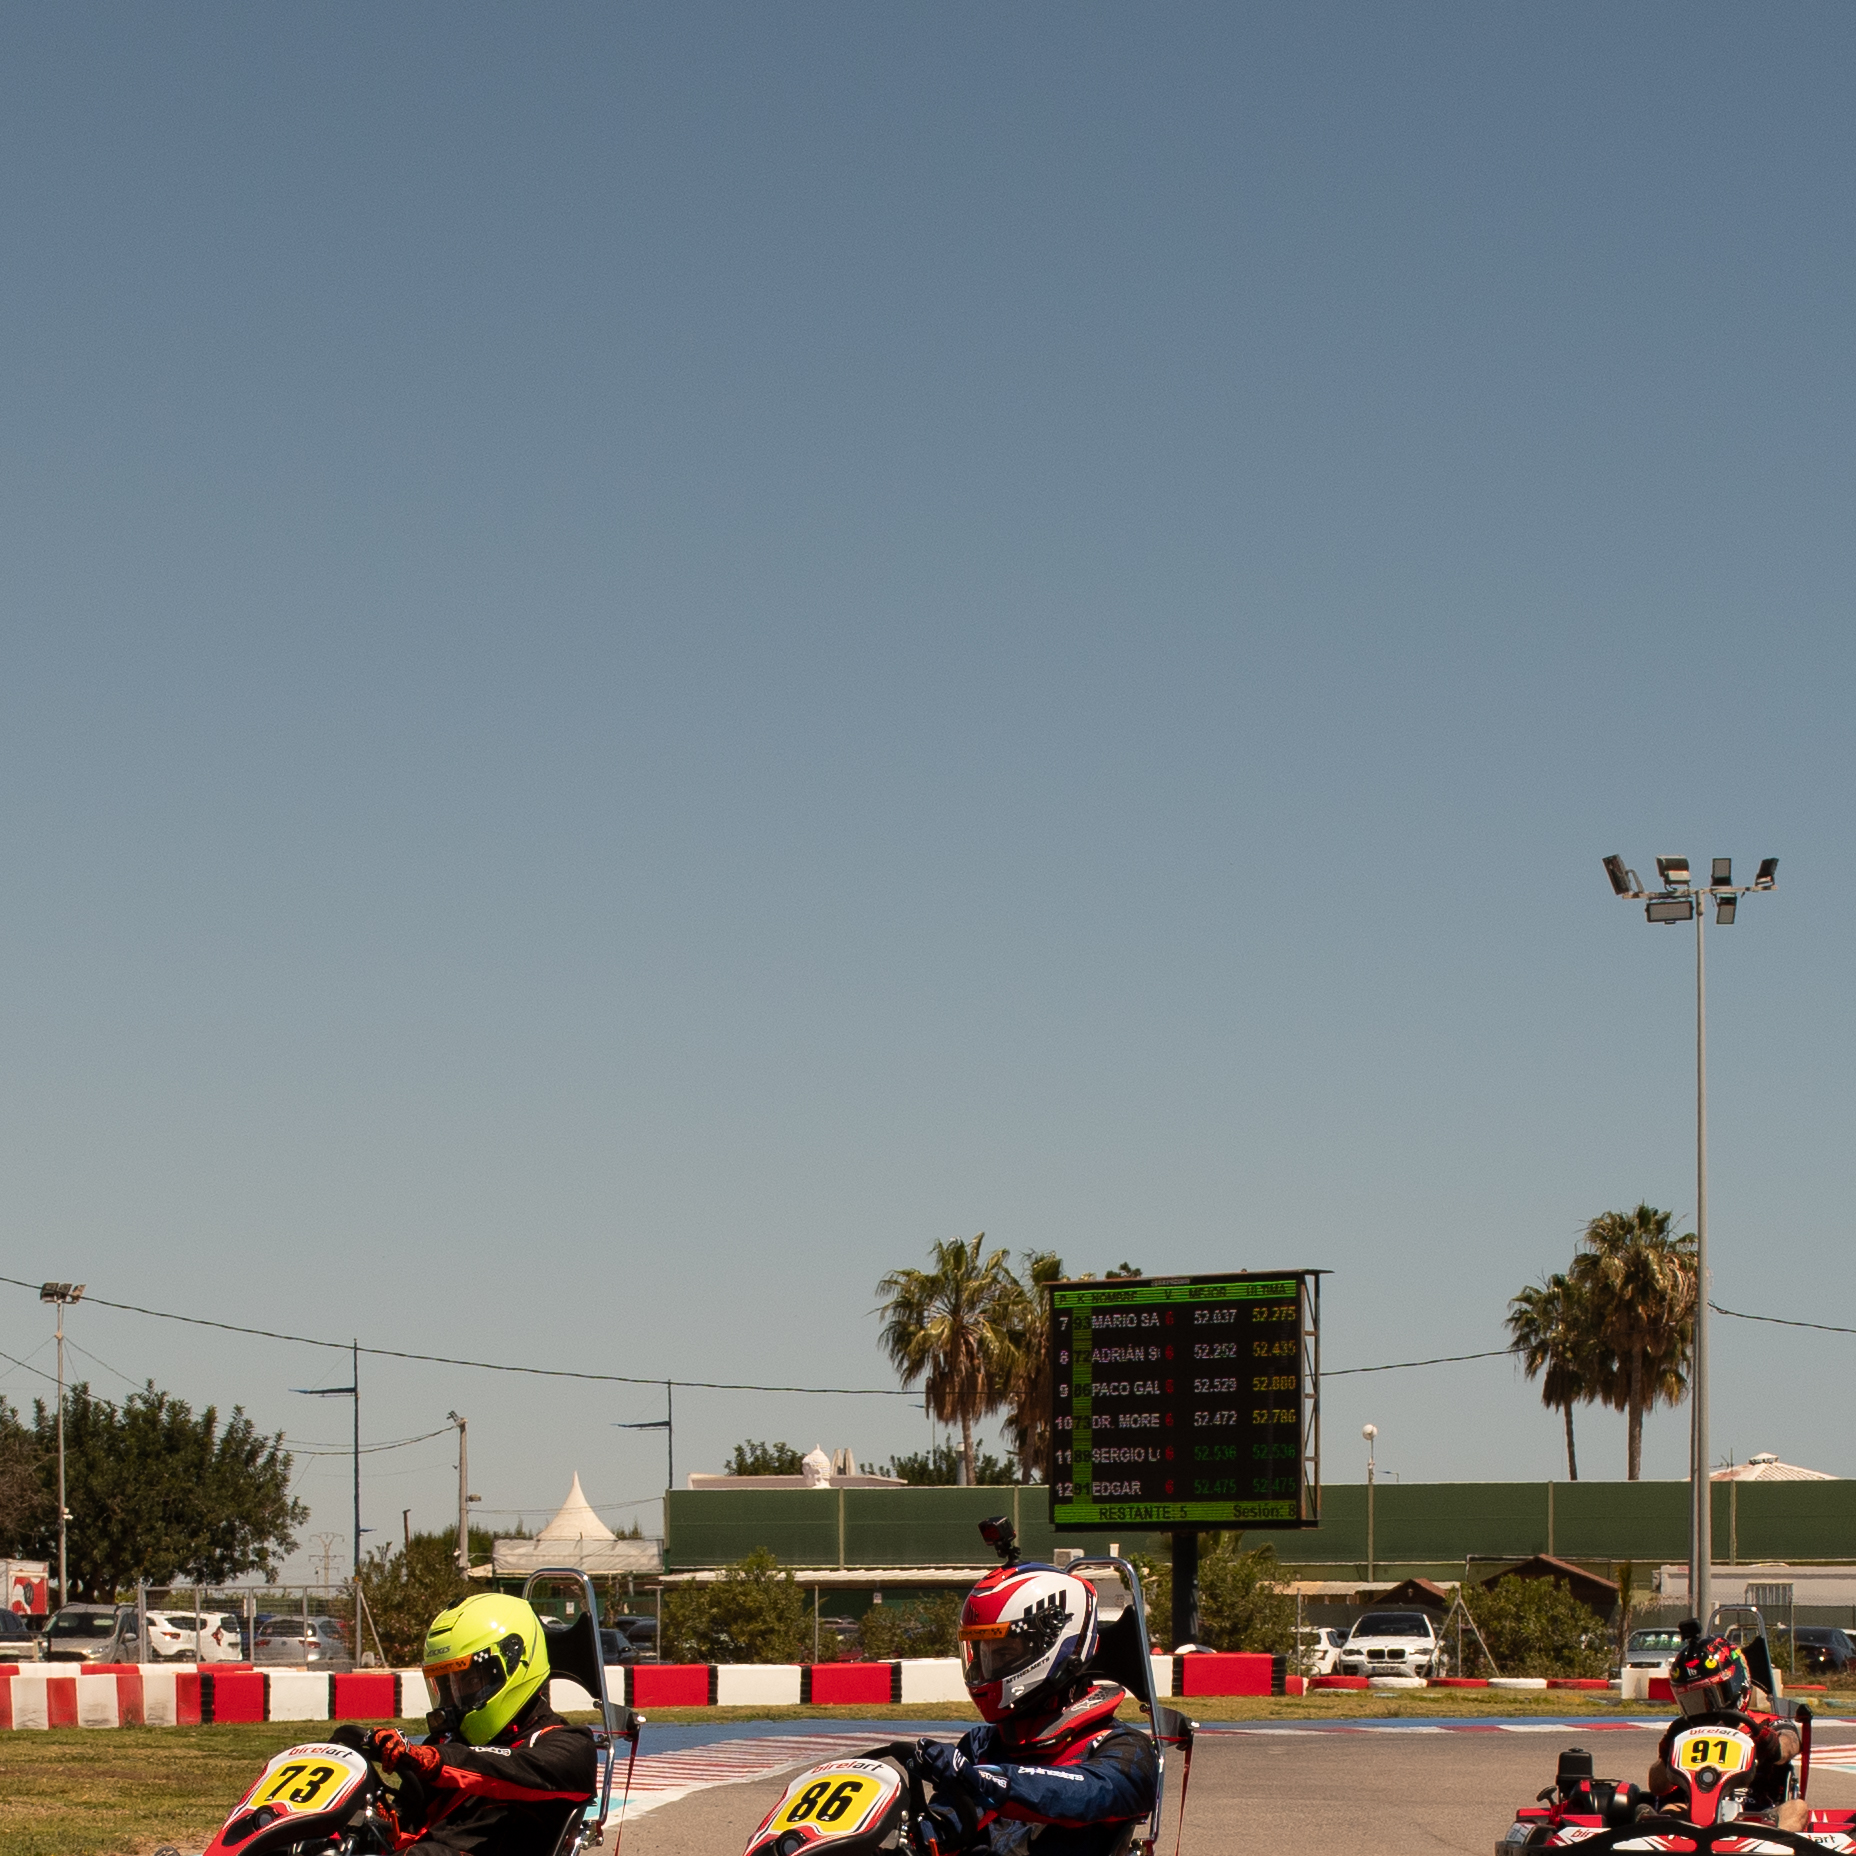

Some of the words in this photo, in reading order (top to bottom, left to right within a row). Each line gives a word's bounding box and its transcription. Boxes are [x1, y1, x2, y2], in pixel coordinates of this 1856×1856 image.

[1059, 1317, 1069, 1331] 7
[1092, 1314, 1138, 1329] MARIO
[1141, 1312, 1160, 1327] SA
[1194, 1309, 1237, 1324] 52.037
[1252, 1306, 1296, 1322] 52.275
[1092, 1344, 1145, 1363] ADRIÁN
[1194, 1343, 1237, 1358] 52.252
[1059, 1384, 1068, 1397] 9
[1073, 1383, 1091, 1397] 86
[1092, 1382, 1130, 1397] PACO
[1134, 1380, 1161, 1395] GAL
[1194, 1378, 1237, 1393] 52.529
[1055, 1416, 1073, 1430] 10
[1092, 1415, 1115, 1429] DR.
[1118, 1413, 1160, 1428] MORE
[1194, 1411, 1237, 1426] 52.472
[1252, 1409, 1296, 1424] 52.786
[1055, 1449, 1072, 1464] 11
[1092, 1448, 1145, 1463] SERGIO
[1055, 1482, 1073, 1496] 12
[1073, 1482, 1091, 1496] 91
[1092, 1481, 1141, 1496] EDGAR
[1194, 1479, 1237, 1494] 52.475
[1252, 1478, 1296, 1493] 52.475
[1099, 1505, 1176, 1520] RESTANTE:
[1180, 1505, 1188, 1519] 5
[1233, 1502, 1283, 1519] Sesión:
[1689, 1728, 1740, 1737] birelart
[288, 1746, 354, 1759] birelart
[1690, 1740, 1729, 1764] 91
[810, 1761, 884, 1775] birelart
[263, 1765, 335, 1804] 73
[786, 1781, 864, 1822] 86
